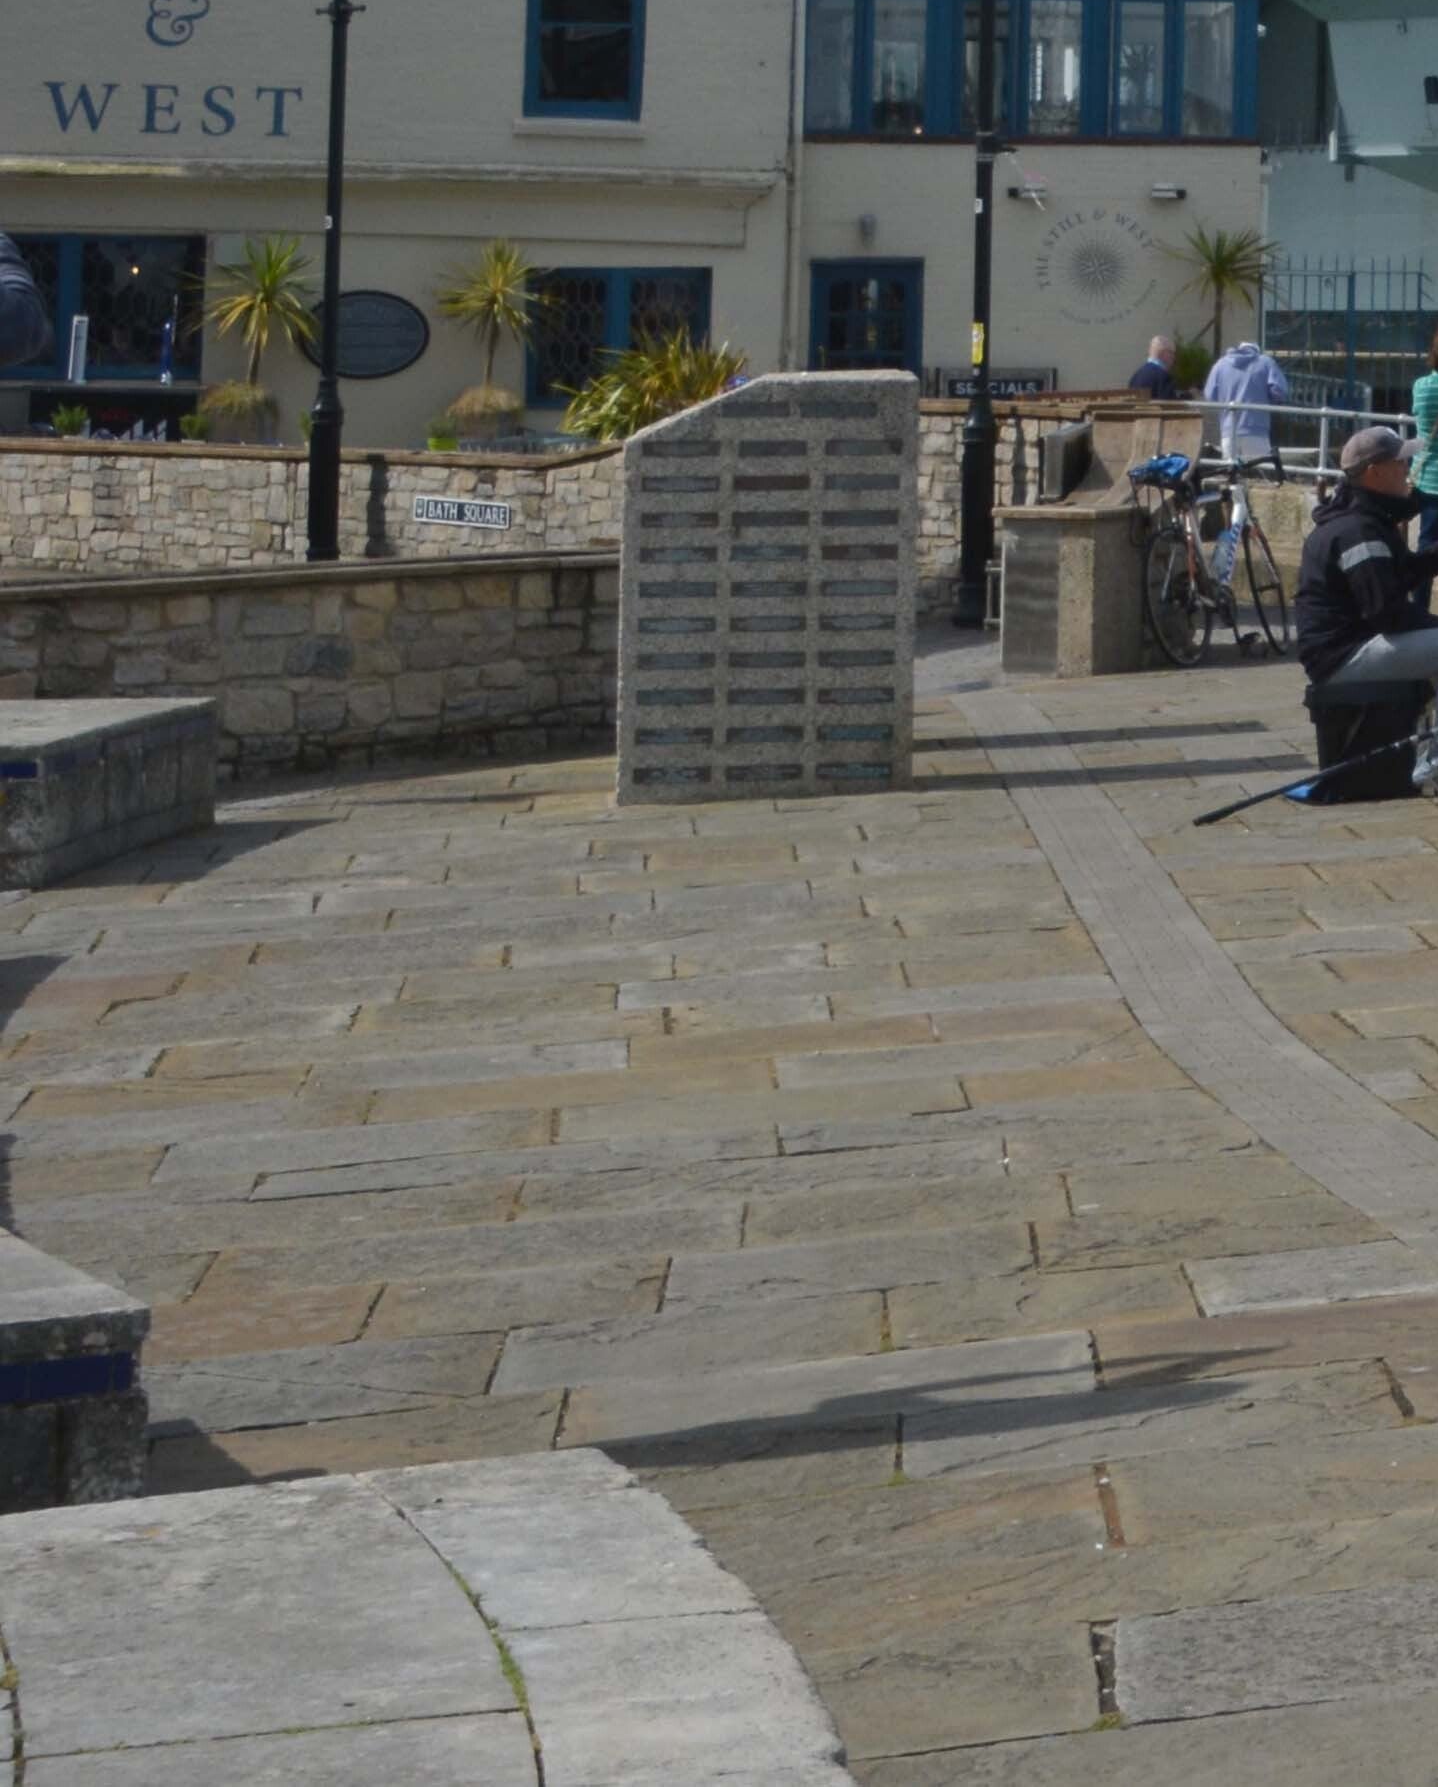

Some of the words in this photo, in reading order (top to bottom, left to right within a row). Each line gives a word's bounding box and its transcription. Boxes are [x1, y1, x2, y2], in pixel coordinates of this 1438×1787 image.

[43, 80, 303, 137] WEST
[427, 501, 459, 520] BATH
[463, 504, 506, 524] SQUARE
